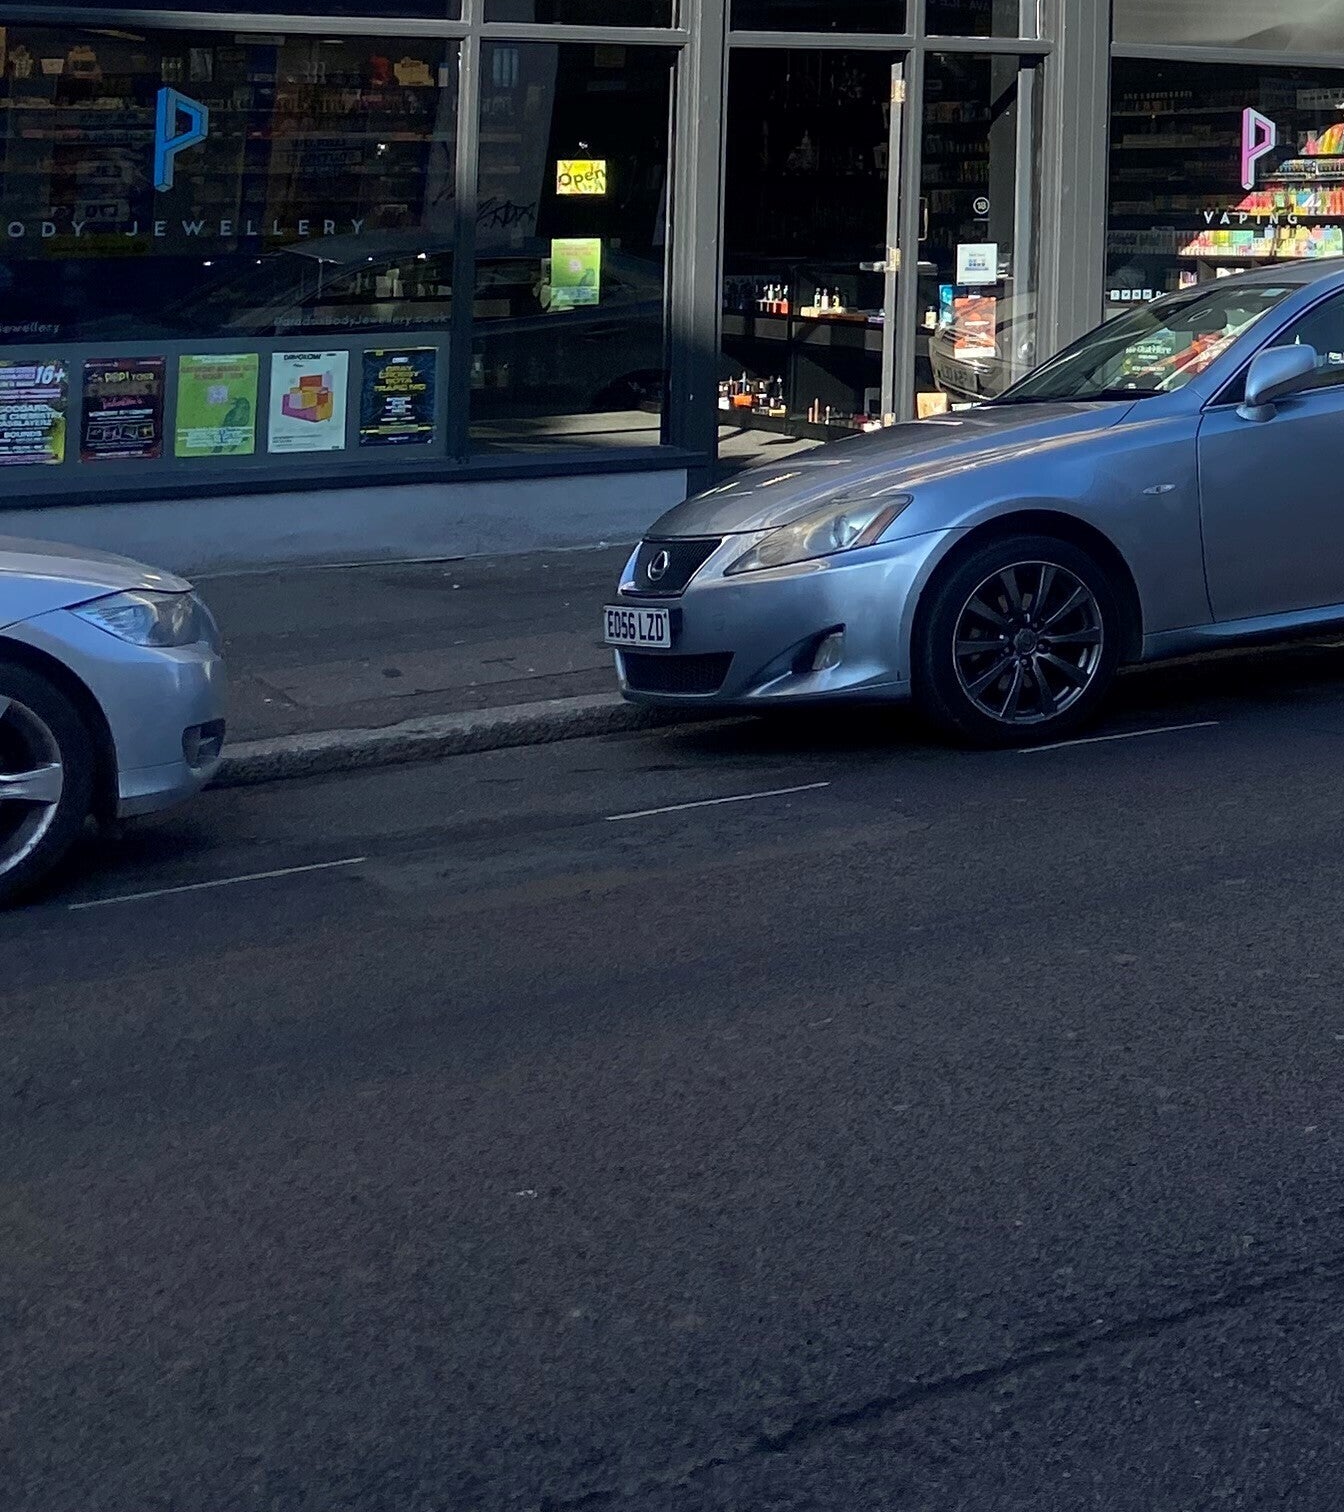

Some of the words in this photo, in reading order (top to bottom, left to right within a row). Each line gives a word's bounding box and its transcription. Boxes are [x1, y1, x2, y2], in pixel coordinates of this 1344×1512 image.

[558, 169, 606, 192] Open
[124, 218, 367, 237] JEWELLERY
[1203, 211, 1299, 225] VAPING
[637, 611, 665, 642] LZD
